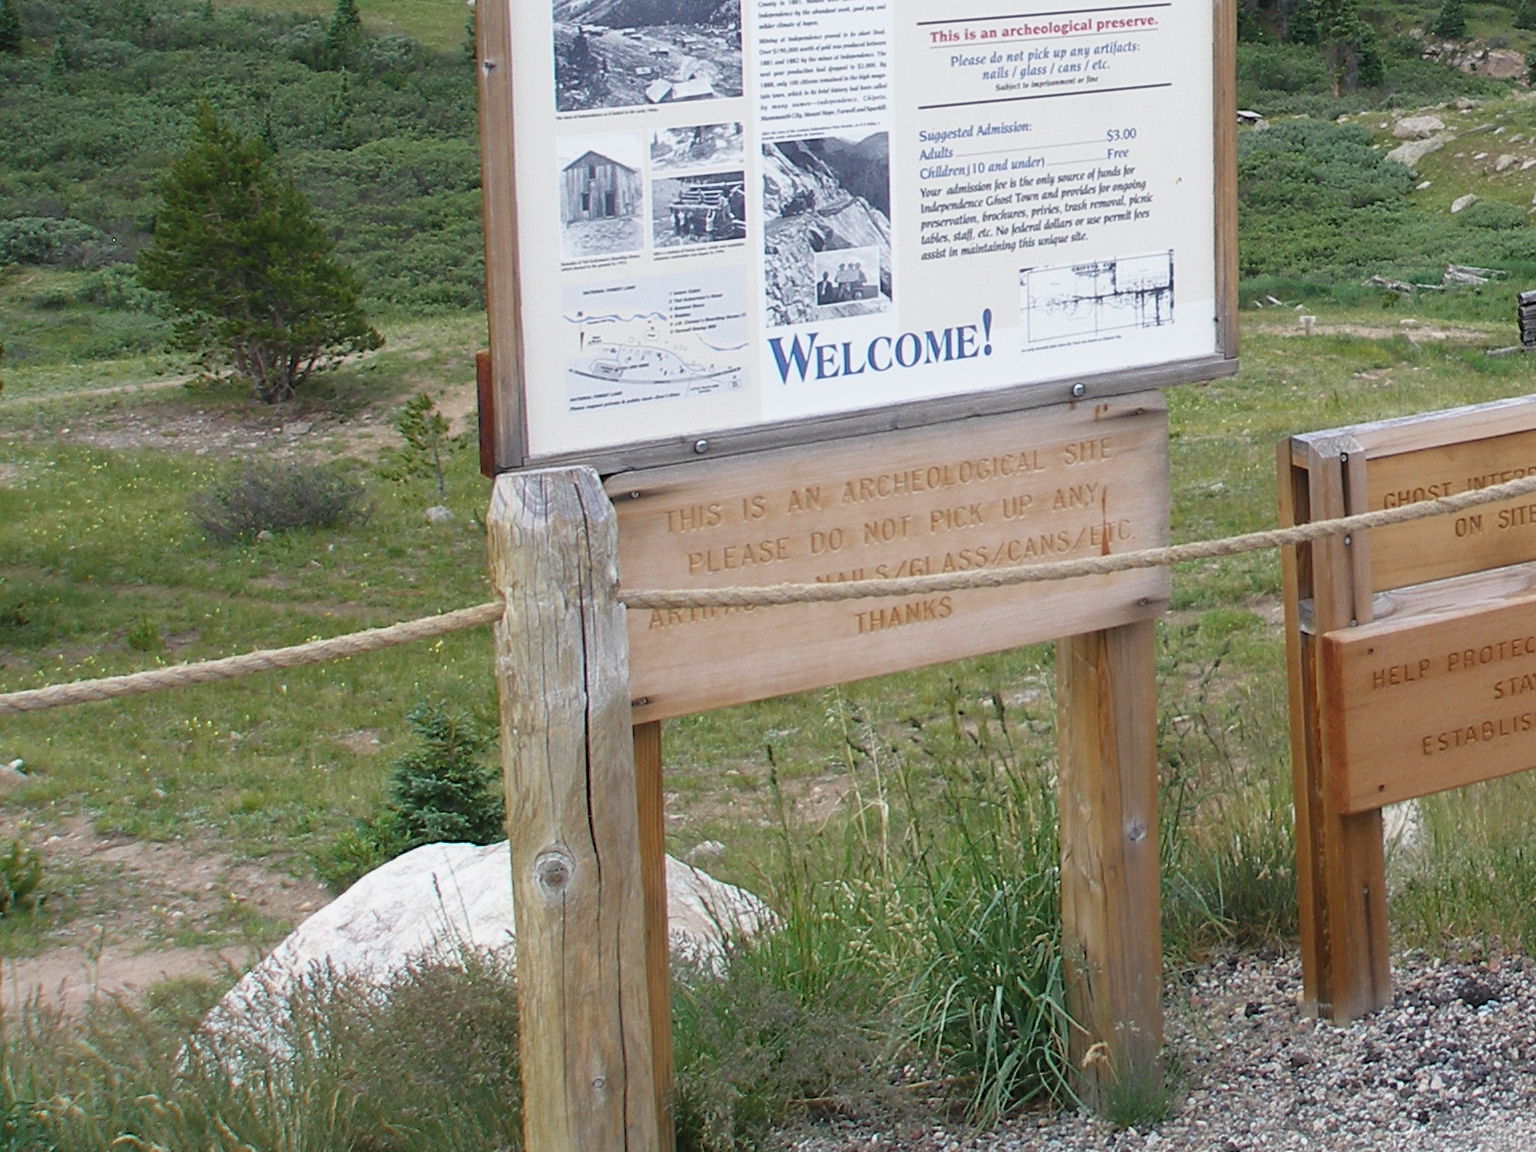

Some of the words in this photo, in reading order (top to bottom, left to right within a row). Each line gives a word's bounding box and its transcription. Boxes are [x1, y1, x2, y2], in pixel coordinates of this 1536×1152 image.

[931, 30, 960, 43] This
[964, 28, 977, 40] is
[980, 29, 998, 39] an
[1002, 18, 1092, 37] archeological
[1097, 15, 1158, 31] preserve.
[950, 54, 986, 67] Please
[989, 51, 1003, 64] do
[1006, 50, 1024, 63] not
[1027, 48, 1050, 63] pick
[1053, 49, 1067, 61] up
[1070, 47, 1090, 59] any
[1093, 42, 1140, 55] artifacts:
[982, 66, 1009, 80] nails
[1020, 64, 1047, 80] glass
[1057, 63, 1082, 74] cans
[1092, 58, 1110, 70] etc.
[919, 126, 974, 144] Suggested
[976, 123, 1032, 136] Admission:
[919, 147, 954, 161] Adults
[1106, 127, 1137, 141] $3.00
[988, 160, 1008, 172] and
[1011, 157, 1045, 169] under)
[1107, 148, 1130, 160] Free
[920, 187, 942, 198] Your
[946, 181, 992, 195] admission
[994, 179, 1008, 192] fee
[1009, 177, 1017, 188] is
[1019, 176, 1035, 188] the
[1035, 173, 1055, 187] only
[1057, 172, 1086, 183] source
[1087, 168, 1096, 182] of
[1097, 166, 1121, 182] funds
[1123, 165, 1136, 178] for
[921, 199, 984, 214] Independence
[985, 194, 1013, 207] Ghost
[1014, 192, 1039, 203] Town
[1041, 188, 1059, 200] and
[1061, 185, 1096, 200] provides
[1098, 183, 1111, 196] for
[1112, 180, 1147, 193] ongoing
[1064, 201, 1087, 212] trash
[1128, 193, 1154, 208] picnic
[996, 225, 1009, 236] No
[1011, 221, 1042, 236] federal
[1043, 219, 1073, 230] dollars
[1074, 218, 1085, 227] or
[1086, 216, 1102, 225] use
[1103, 211, 1132, 225] permit
[1133, 210, 1150, 222] fees
[921, 248, 946, 261] assist
[948, 246, 958, 258] in
[961, 241, 1016, 256] maintaining
[1018, 237, 1036, 249] this
[1038, 235, 1069, 247] unique
[768, 308, 993, 385] WELCOME!
[664, 503, 723, 534] THIS
[742, 495, 767, 521] IS
[787, 485, 822, 514] AN
[842, 449, 1045, 502] ARCHEOLOGICAL
[1383, 481, 1452, 510] GHOST
[688, 537, 791, 574] PLEASE
[810, 528, 844, 554] DO
[864, 515, 912, 545] NOT
[931, 503, 985, 533] PICK
[1002, 495, 1033, 520] UP
[1051, 482, 1099, 511] ANY
[1455, 515, 1483, 538] ON
[854, 596, 954, 634] THANKS
[1373, 658, 1431, 690] HELP
